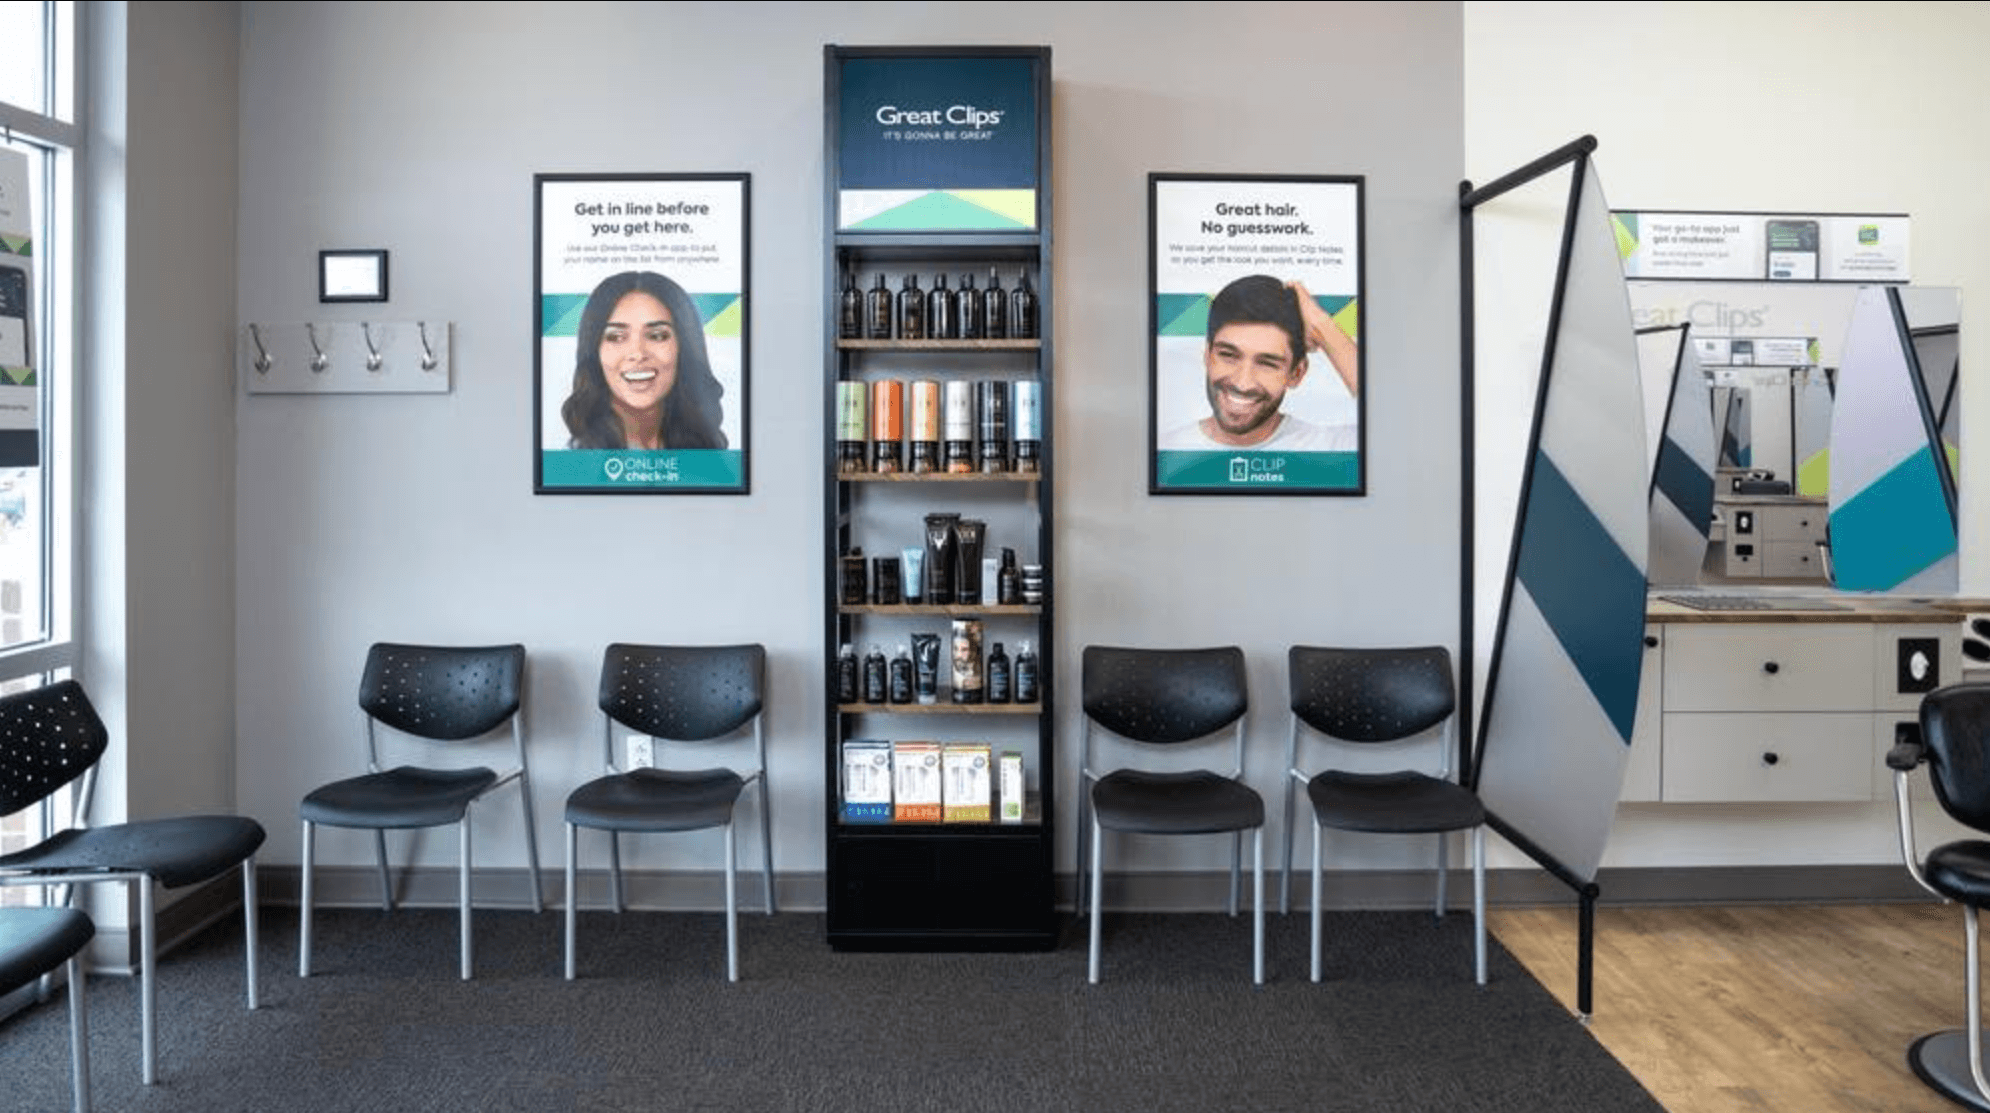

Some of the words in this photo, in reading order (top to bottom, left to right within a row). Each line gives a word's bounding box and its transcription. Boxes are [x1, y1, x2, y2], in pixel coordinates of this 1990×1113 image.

[876, 105, 942, 125] Great
[904, 131, 940, 140] GONNA
[943, 131, 957, 140] BE
[960, 131, 992, 140] GREAT
[574, 202, 604, 216] Get
[607, 202, 622, 216] in
[625, 202, 653, 216] line
[656, 201, 710, 216] before
[1216, 202, 1262, 216] Great
[1265, 202, 1299, 216] hair.
[591, 222, 620, 237] you
[623, 221, 650, 237] get
[654, 220, 694, 234] here.
[1201, 221, 1223, 234] No
[1227, 221, 1314, 237] guesswork.
[624, 457, 679, 470] ONLINE
[1250, 457, 1286, 471] CLIP
[1250, 473, 1285, 481] notes
